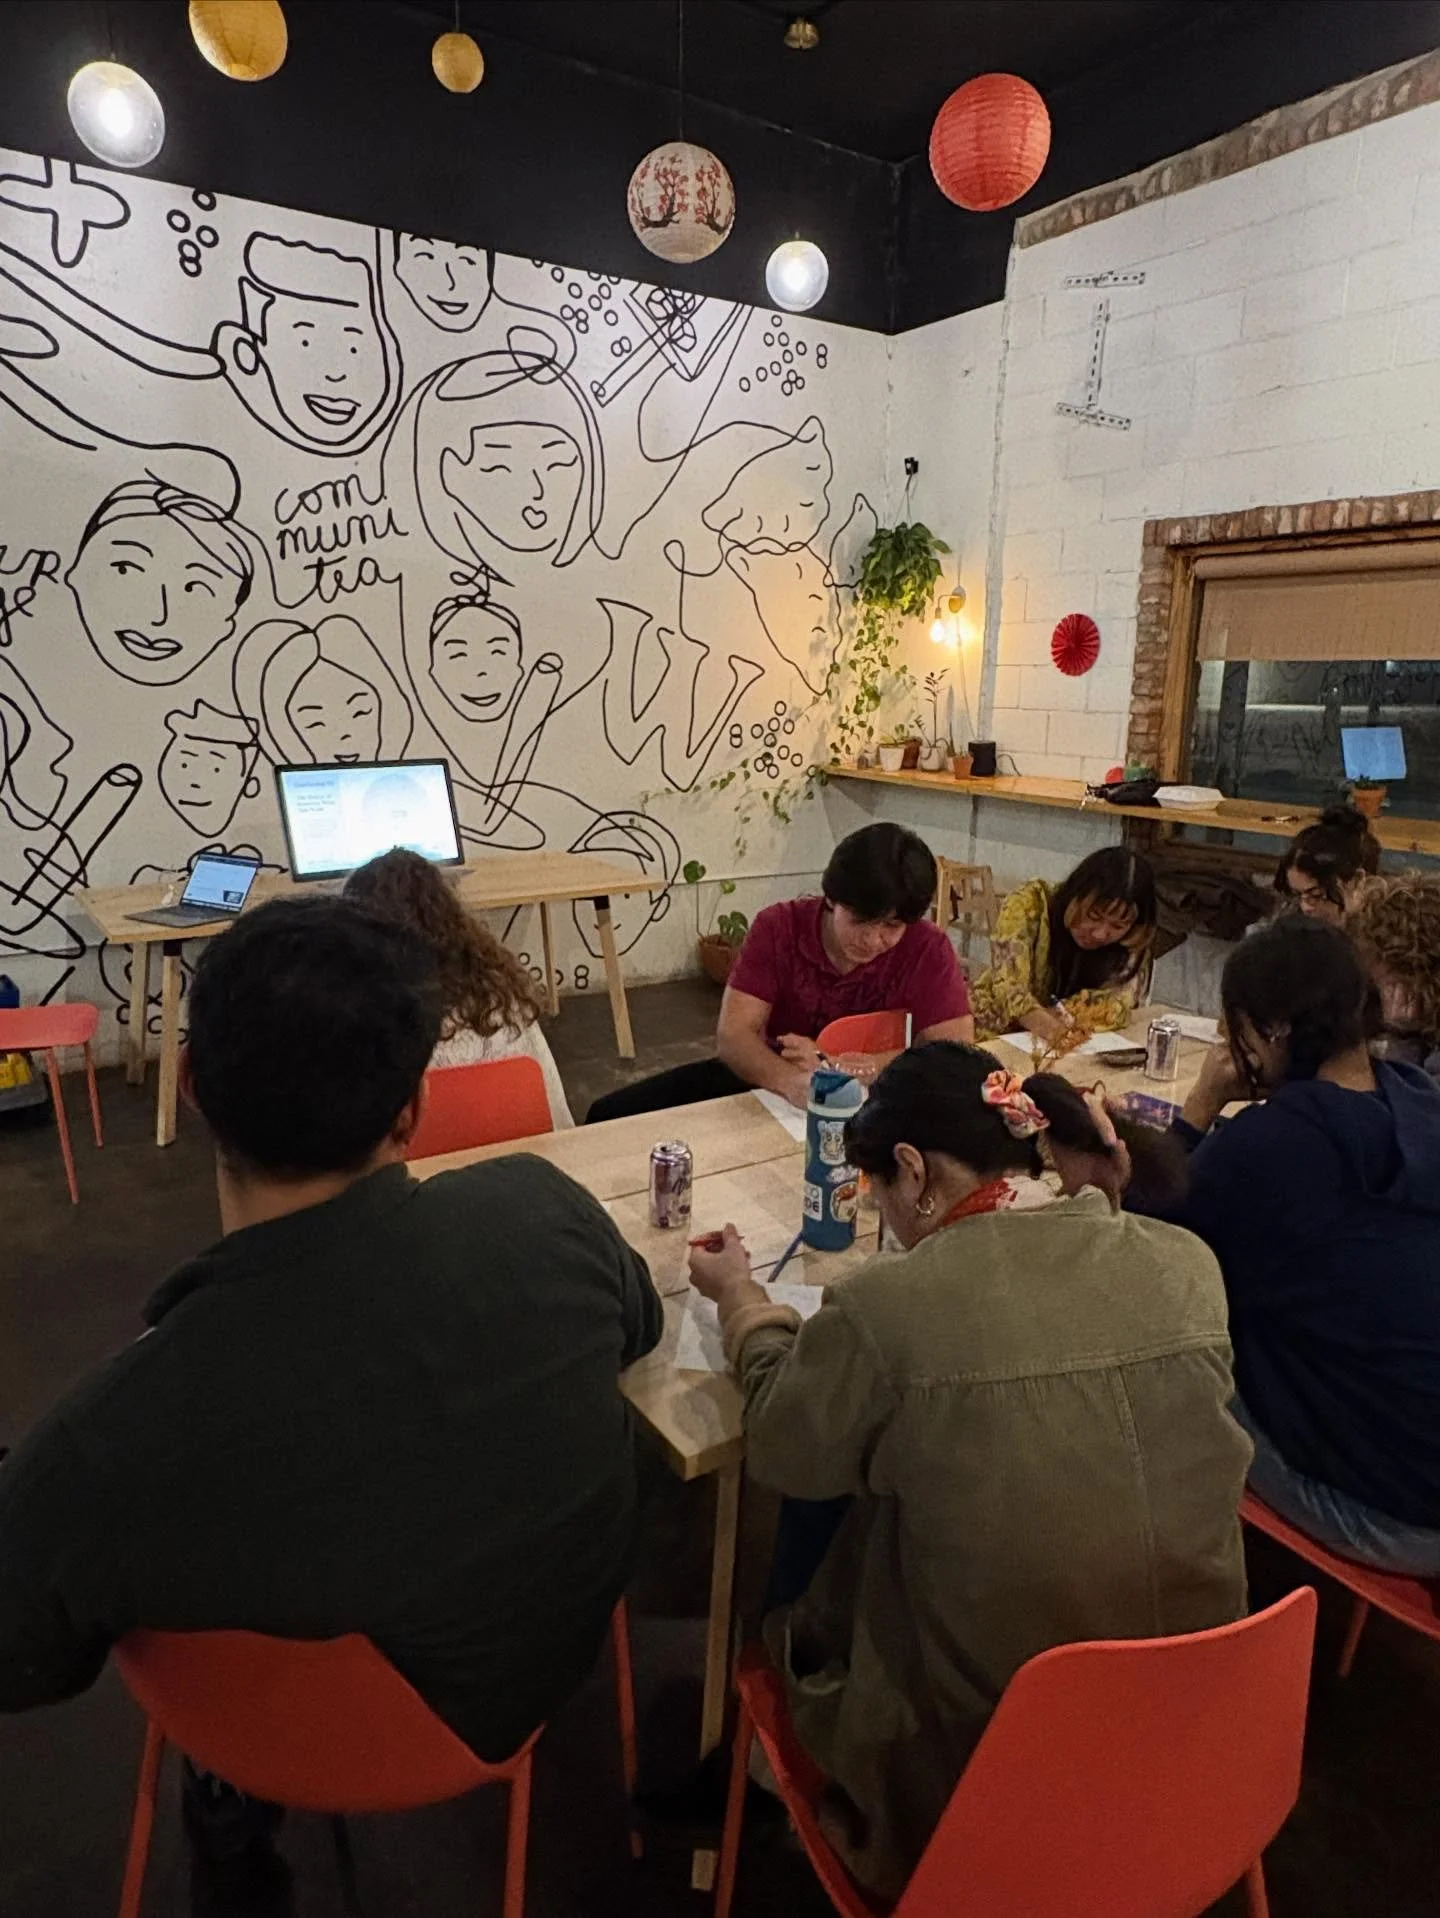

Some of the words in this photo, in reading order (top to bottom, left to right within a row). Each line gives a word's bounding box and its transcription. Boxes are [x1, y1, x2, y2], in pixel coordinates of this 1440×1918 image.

[275, 473, 384, 525] com
[276, 505, 409, 560] muni
[303, 556, 402, 604] tea
